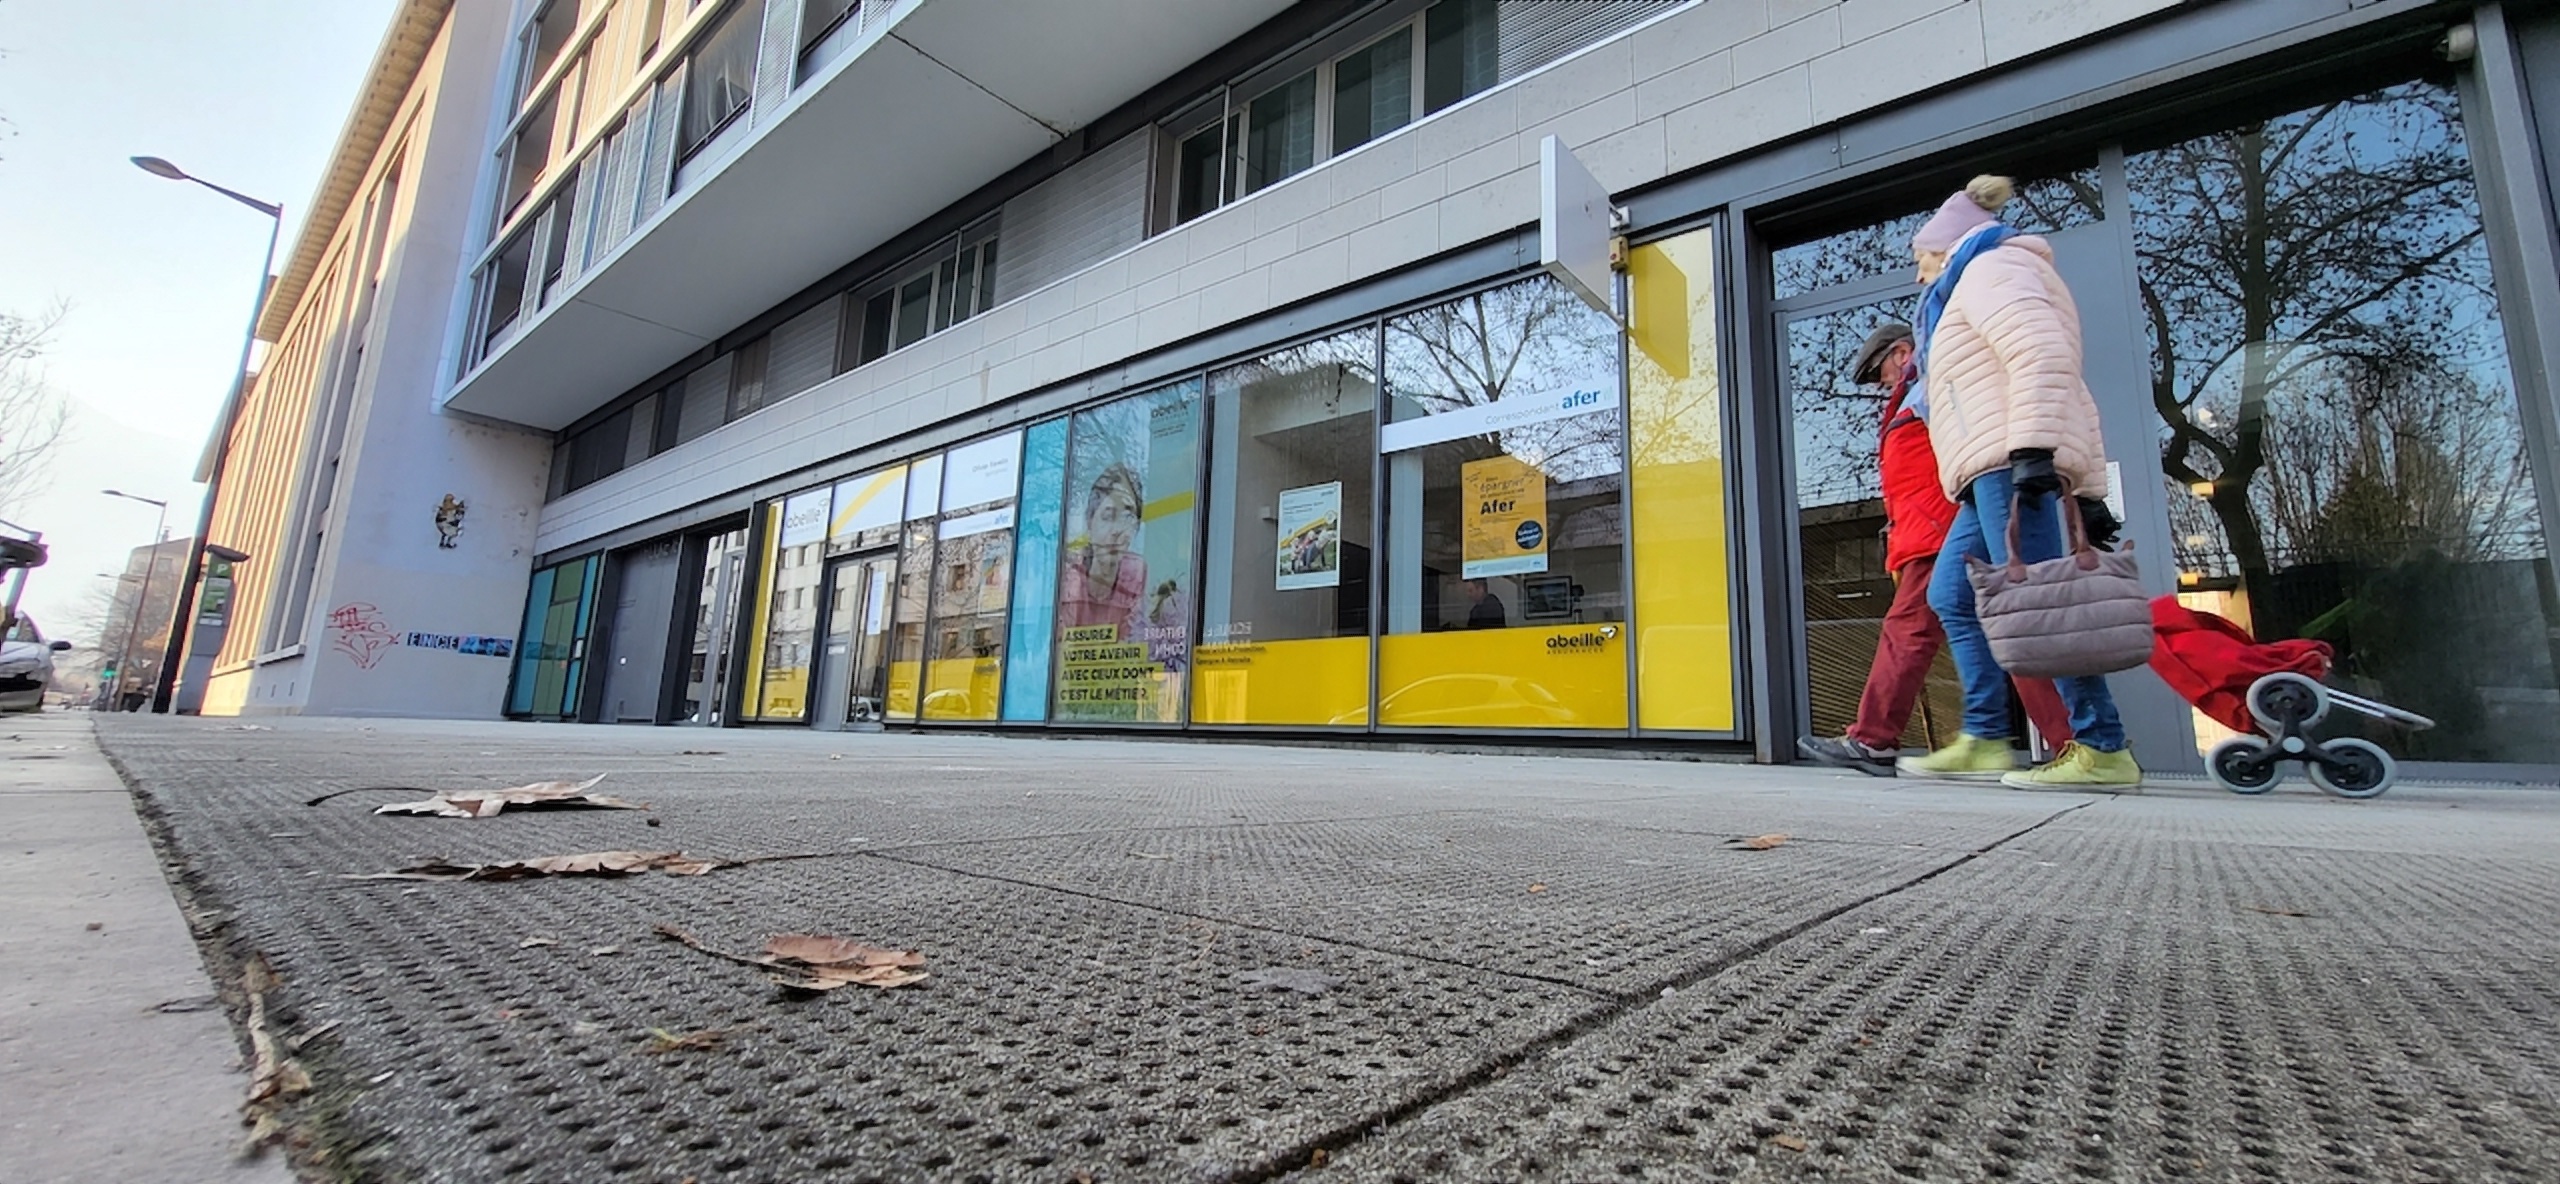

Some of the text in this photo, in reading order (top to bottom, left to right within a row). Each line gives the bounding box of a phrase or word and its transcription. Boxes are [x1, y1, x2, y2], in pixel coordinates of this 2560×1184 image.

[1562, 389, 1601, 409] afer
[1480, 499, 1517, 515] Afer
[217, 563, 228, 574] P
[1065, 628, 1113, 641] ASSUREZ
[1546, 632, 1605, 648] abeille
[1063, 647, 1141, 661] VOTRE AVENIR
[1061, 667, 1155, 680] AVEC CEUX DONT
[1060, 688, 1088, 700] C'EST
[1090, 689, 1103, 700] LE
